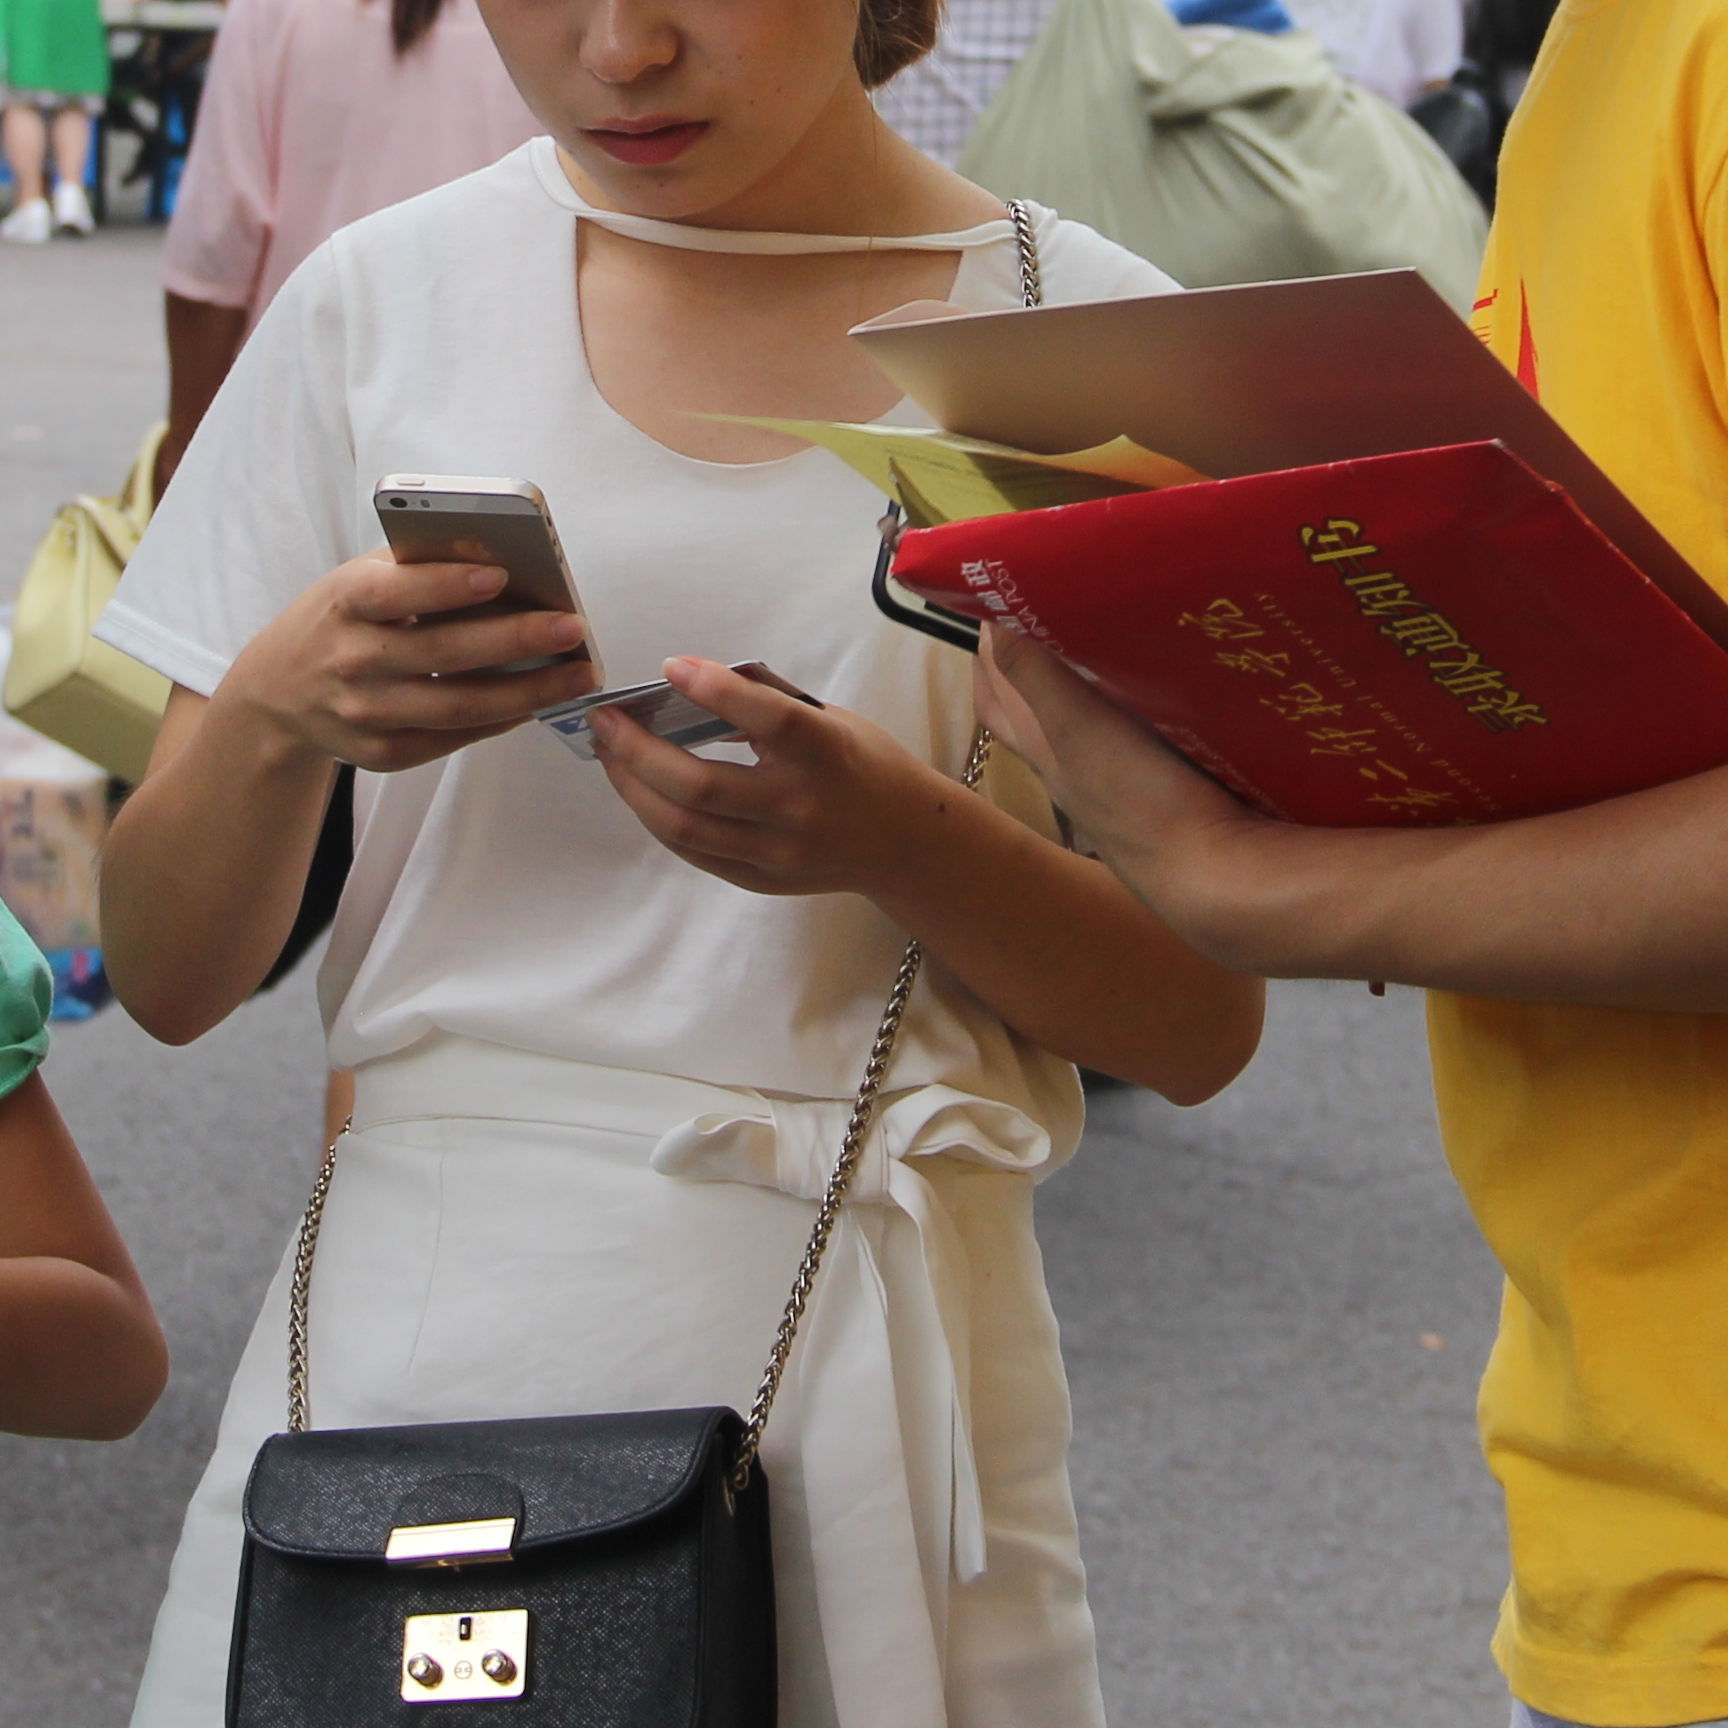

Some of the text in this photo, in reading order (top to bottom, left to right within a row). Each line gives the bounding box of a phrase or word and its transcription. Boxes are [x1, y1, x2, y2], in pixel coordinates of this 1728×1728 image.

[985, 558, 1024, 604] POST
[1300, 519, 1548, 734] 录取通知书
[1255, 592, 1503, 812] Second Normal University
